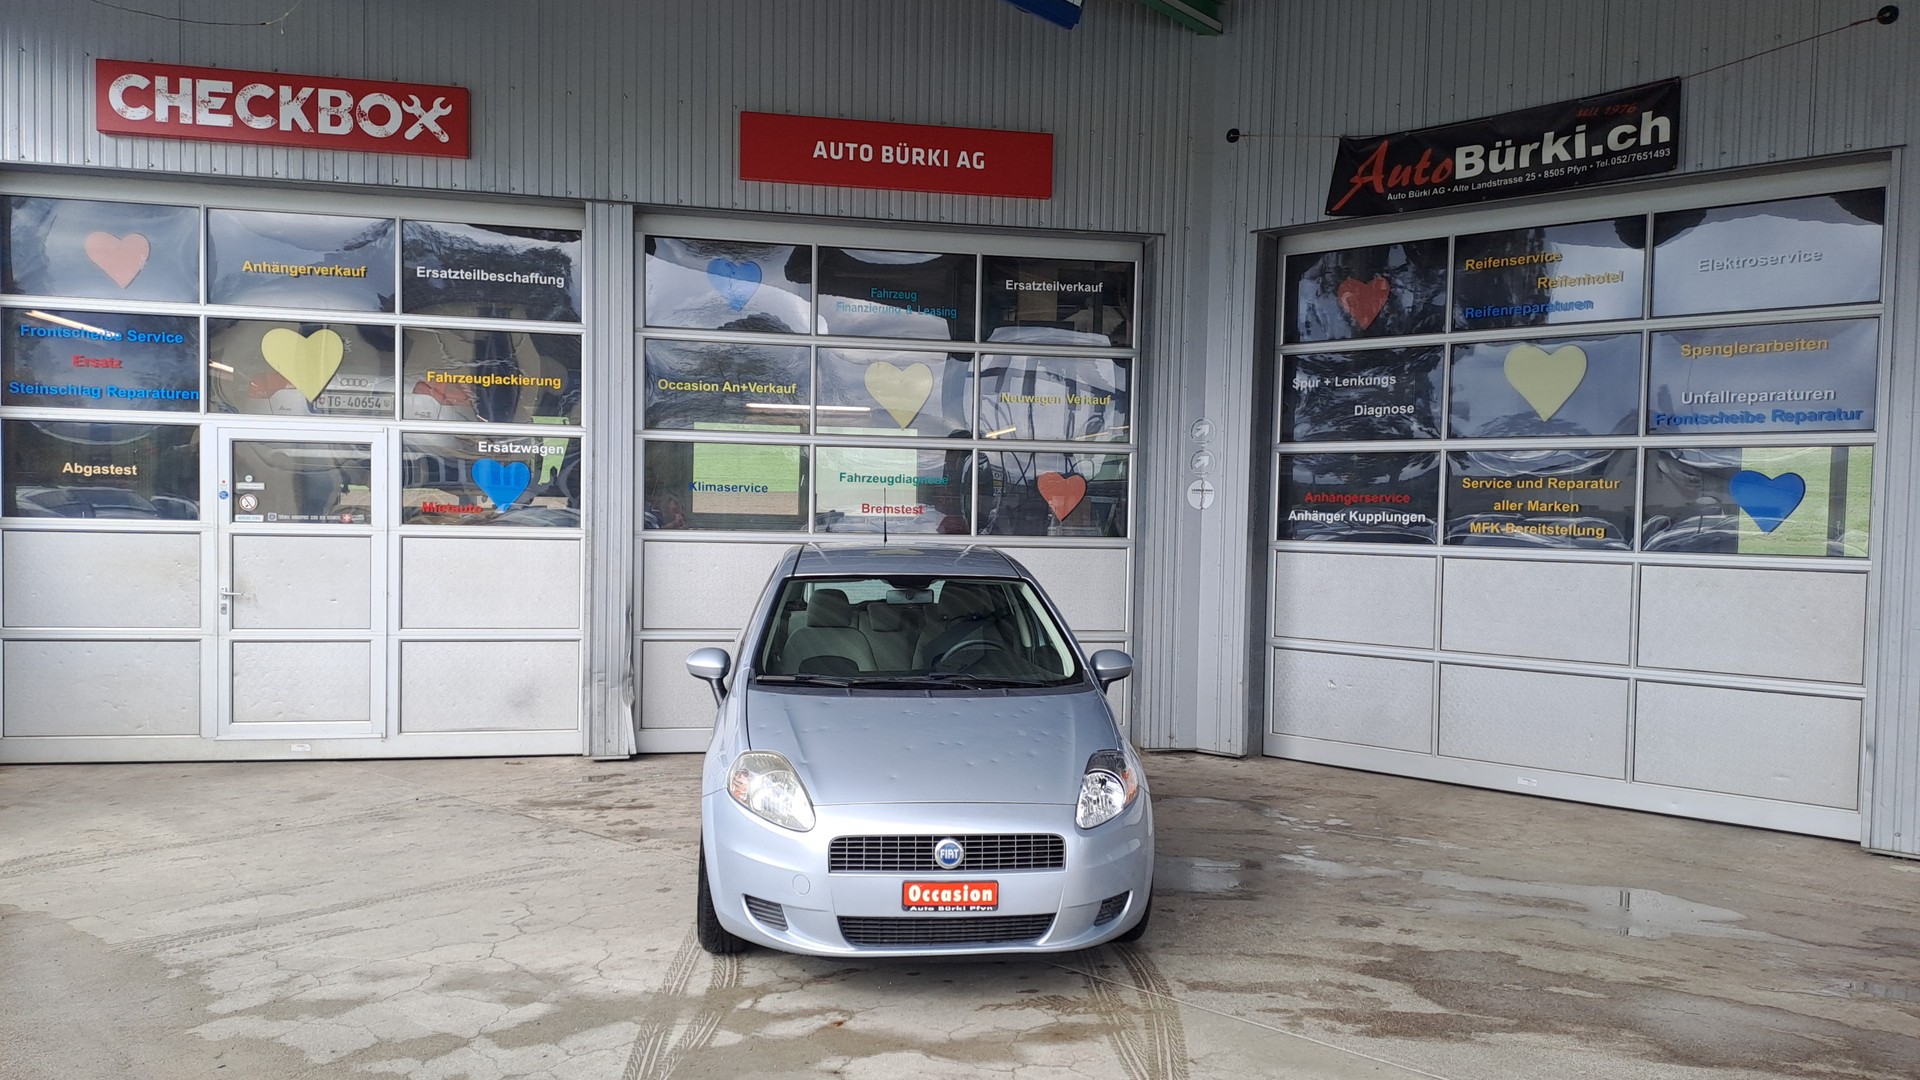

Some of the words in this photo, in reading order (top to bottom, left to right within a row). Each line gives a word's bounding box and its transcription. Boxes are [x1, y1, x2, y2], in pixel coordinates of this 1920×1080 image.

[108, 73, 452, 143] CHECKBOX
[1604, 102, 1638, 115] 1976
[813, 141, 873, 162] AUTO
[881, 142, 949, 167] BÜRKI
[956, 151, 985, 169] AG
[1387, 192, 1406, 201] Auto
[1408, 189, 1431, 198] Bürki
[1432, 187, 1445, 196] AG
[1452, 183, 1469, 193] Alte
[1471, 175, 1523, 190] Landstrasse
[1525, 173, 1536, 182] 25
[1544, 169, 1565, 179] 8505
[1567, 165, 1587, 175] Pfyn
[242, 260, 367, 278] Anhängerverkauf
[1465, 252, 1563, 271] Reifenservice
[1699, 250, 1823, 272] Elektroservice
[416, 266, 565, 289] Ersatzteilbeschaffung
[1005, 279, 1103, 292] Ersatzteilverkauf
[1537, 270, 1624, 289] Reifenhotel
[870, 287, 917, 301] Fahrzeug
[836, 301, 900, 315] Finanzierung
[906, 305, 913, 315] &
[917, 305, 957, 319] Leasing
[1465, 300, 1594, 319] Reifenreparaturen
[20, 324, 122, 341] Frontscheibe
[127, 329, 184, 344] Service
[1680, 338, 1828, 359] Spenglerarbeiten
[72, 354, 123, 369] Ersatz
[427, 371, 561, 389] Fahrzeuglackierung
[658, 379, 719, 392] Occasion
[722, 381, 797, 394] An+Verkauf
[1292, 378, 1320, 391] Spur
[1324, 378, 1331, 386] +
[1335, 375, 1396, 388] Lenkungs
[9, 381, 101, 399] Steinschlag
[106, 384, 199, 400] Reparaturen
[1681, 387, 1836, 405] Unfallreparaturen
[1001, 392, 1062, 405] Neuwagen
[1066, 394, 1112, 406] Verkauf
[1354, 404, 1415, 417] Diagnose
[1655, 411, 1766, 426] Frontscheibe
[1772, 408, 1863, 425] Reparatur
[478, 441, 564, 457] Ersatzwagen
[62, 462, 137, 478] Abgastest
[689, 481, 768, 493] Klimaservice
[839, 472, 949, 486] Fahrzeugdiagnose
[1462, 478, 1512, 489] Service
[1517, 478, 1543, 489] und
[1548, 478, 1620, 491] Reparatur
[1305, 492, 1412, 506] Anhängerservice
[1494, 500, 1523, 511] aller
[1528, 500, 1579, 512] Marken
[422, 502, 483, 514] Mietauto
[861, 503, 924, 515] Bremstest
[1288, 510, 1346, 523] Anhänger
[1349, 511, 1425, 524] Kupplungen
[1470, 522, 1605, 539] MFK-Bereitstellung
[940, 848, 959, 859] FIAT
[908, 884, 993, 902] Occasion
